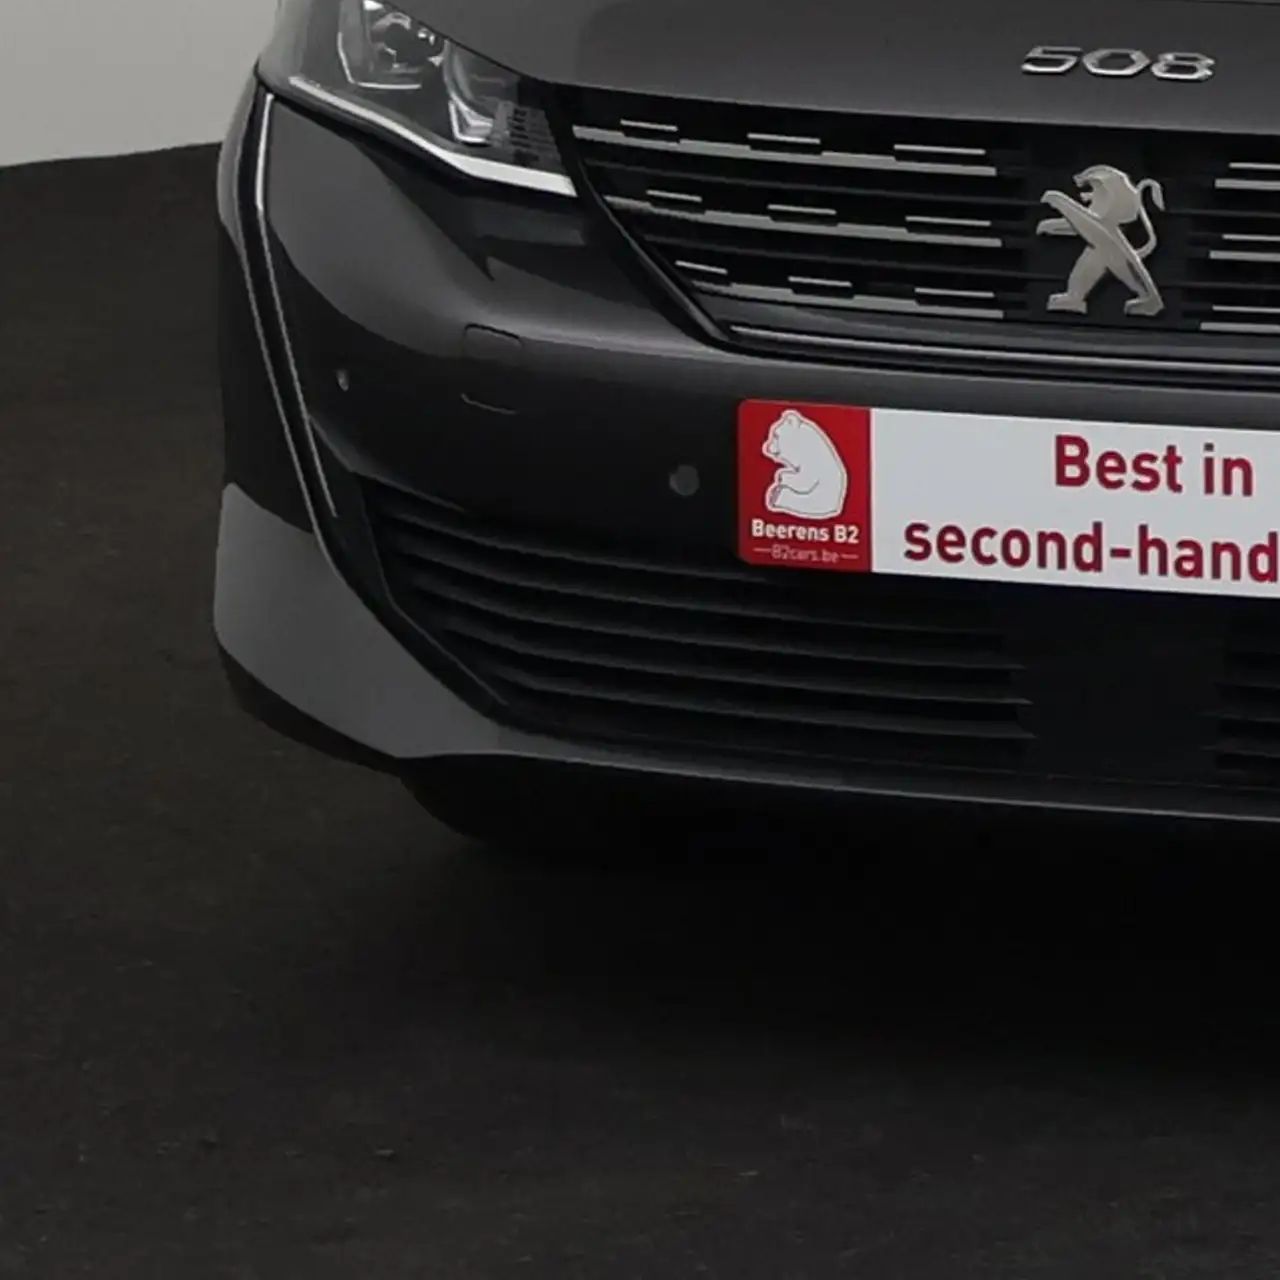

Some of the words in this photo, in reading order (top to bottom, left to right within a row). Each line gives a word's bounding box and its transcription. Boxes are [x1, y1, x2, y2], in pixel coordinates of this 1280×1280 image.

[1021, 45, 1215, 81] 508
[1054, 434, 1183, 494] Best
[1203, 442, 1254, 497] in
[751, 519, 830, 542] Beerens
[833, 524, 860, 544] B2
[903, 521, 1279, 583] second-hand
